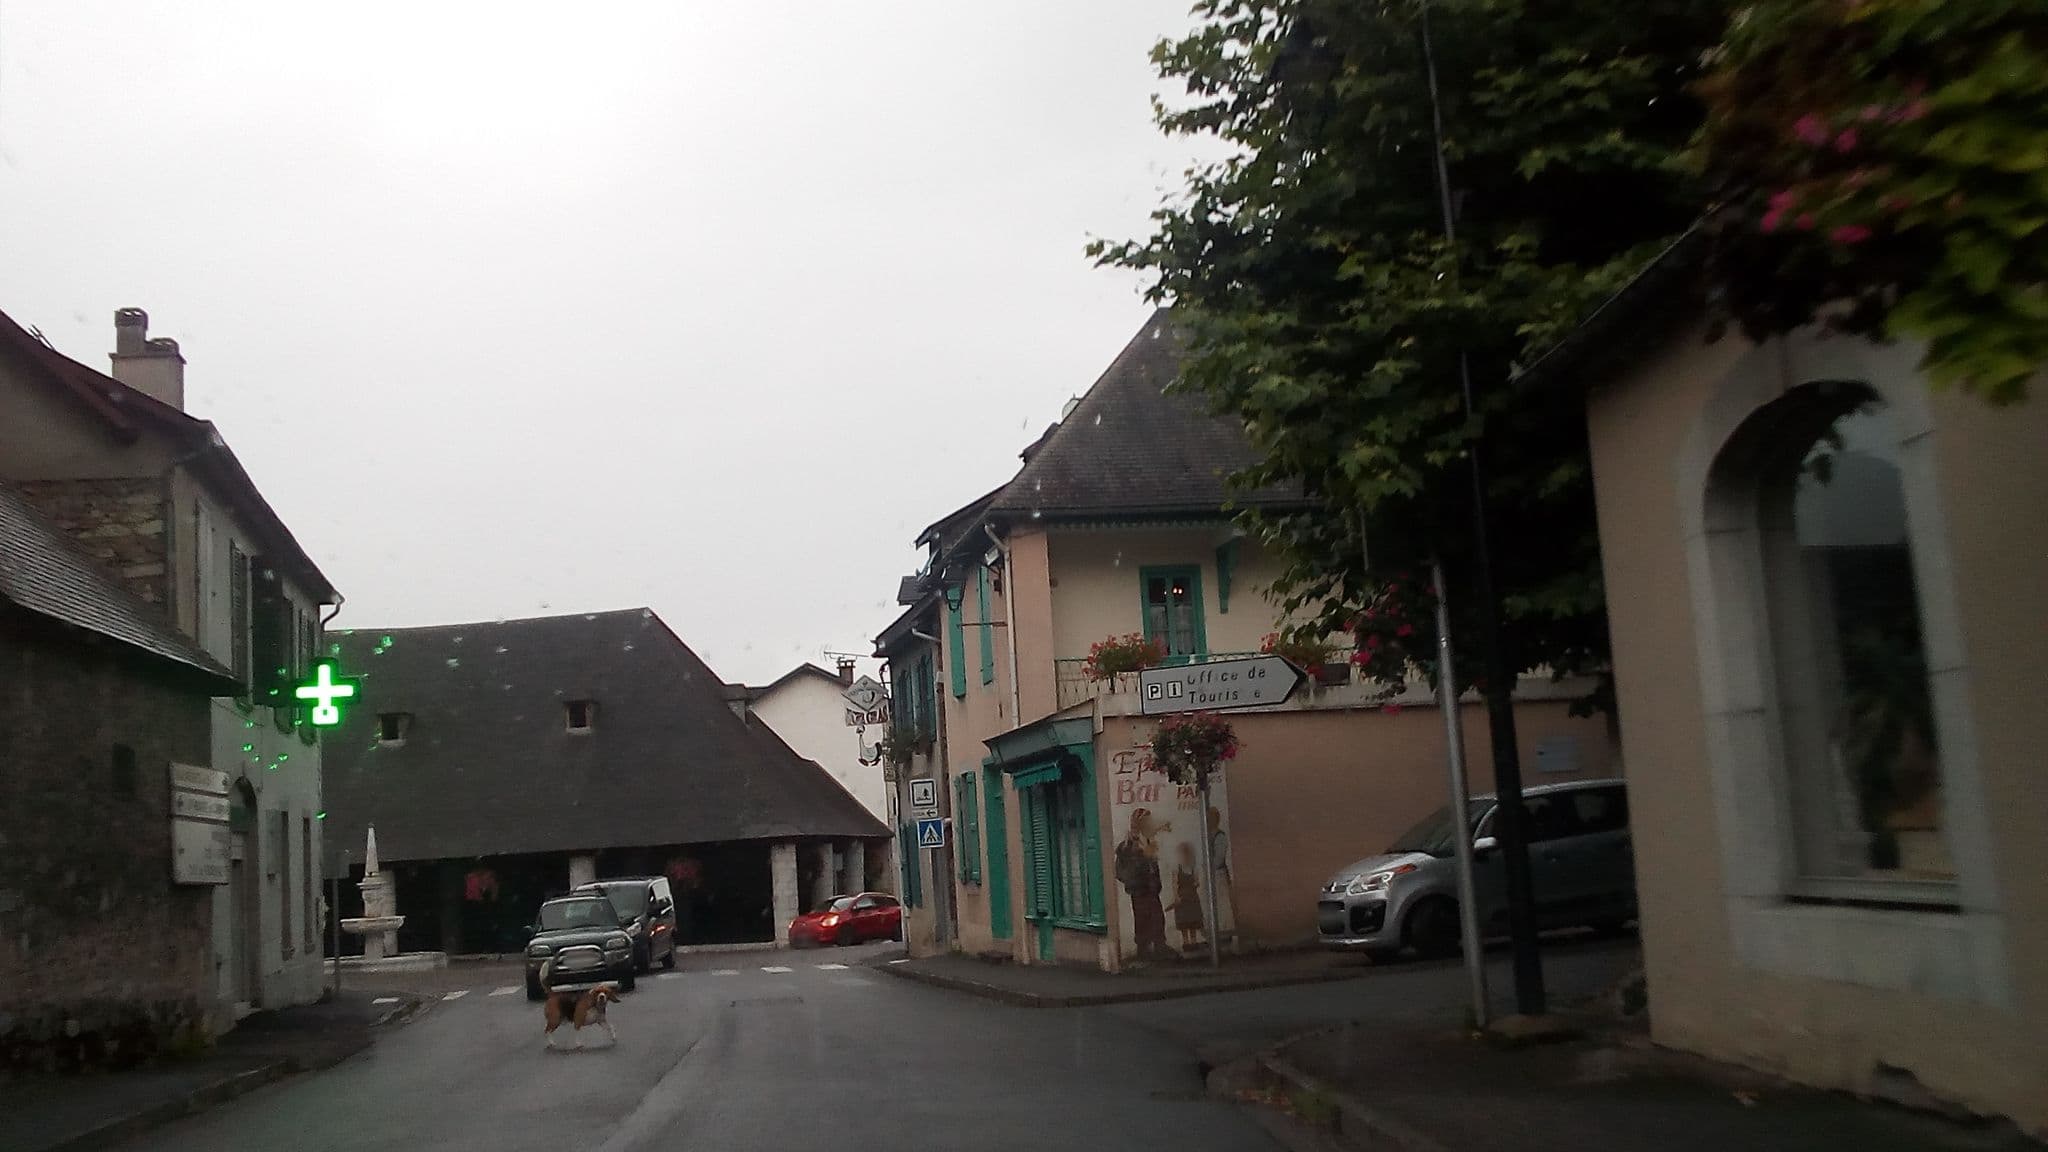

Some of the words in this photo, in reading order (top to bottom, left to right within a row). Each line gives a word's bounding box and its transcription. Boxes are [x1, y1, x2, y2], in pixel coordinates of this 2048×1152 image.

[1187, 670, 1238, 685] Offce
[1248, 666, 1266, 680] de
[1188, 690, 1262, 704] Tourise
[1116, 779, 1166, 805] Bar
